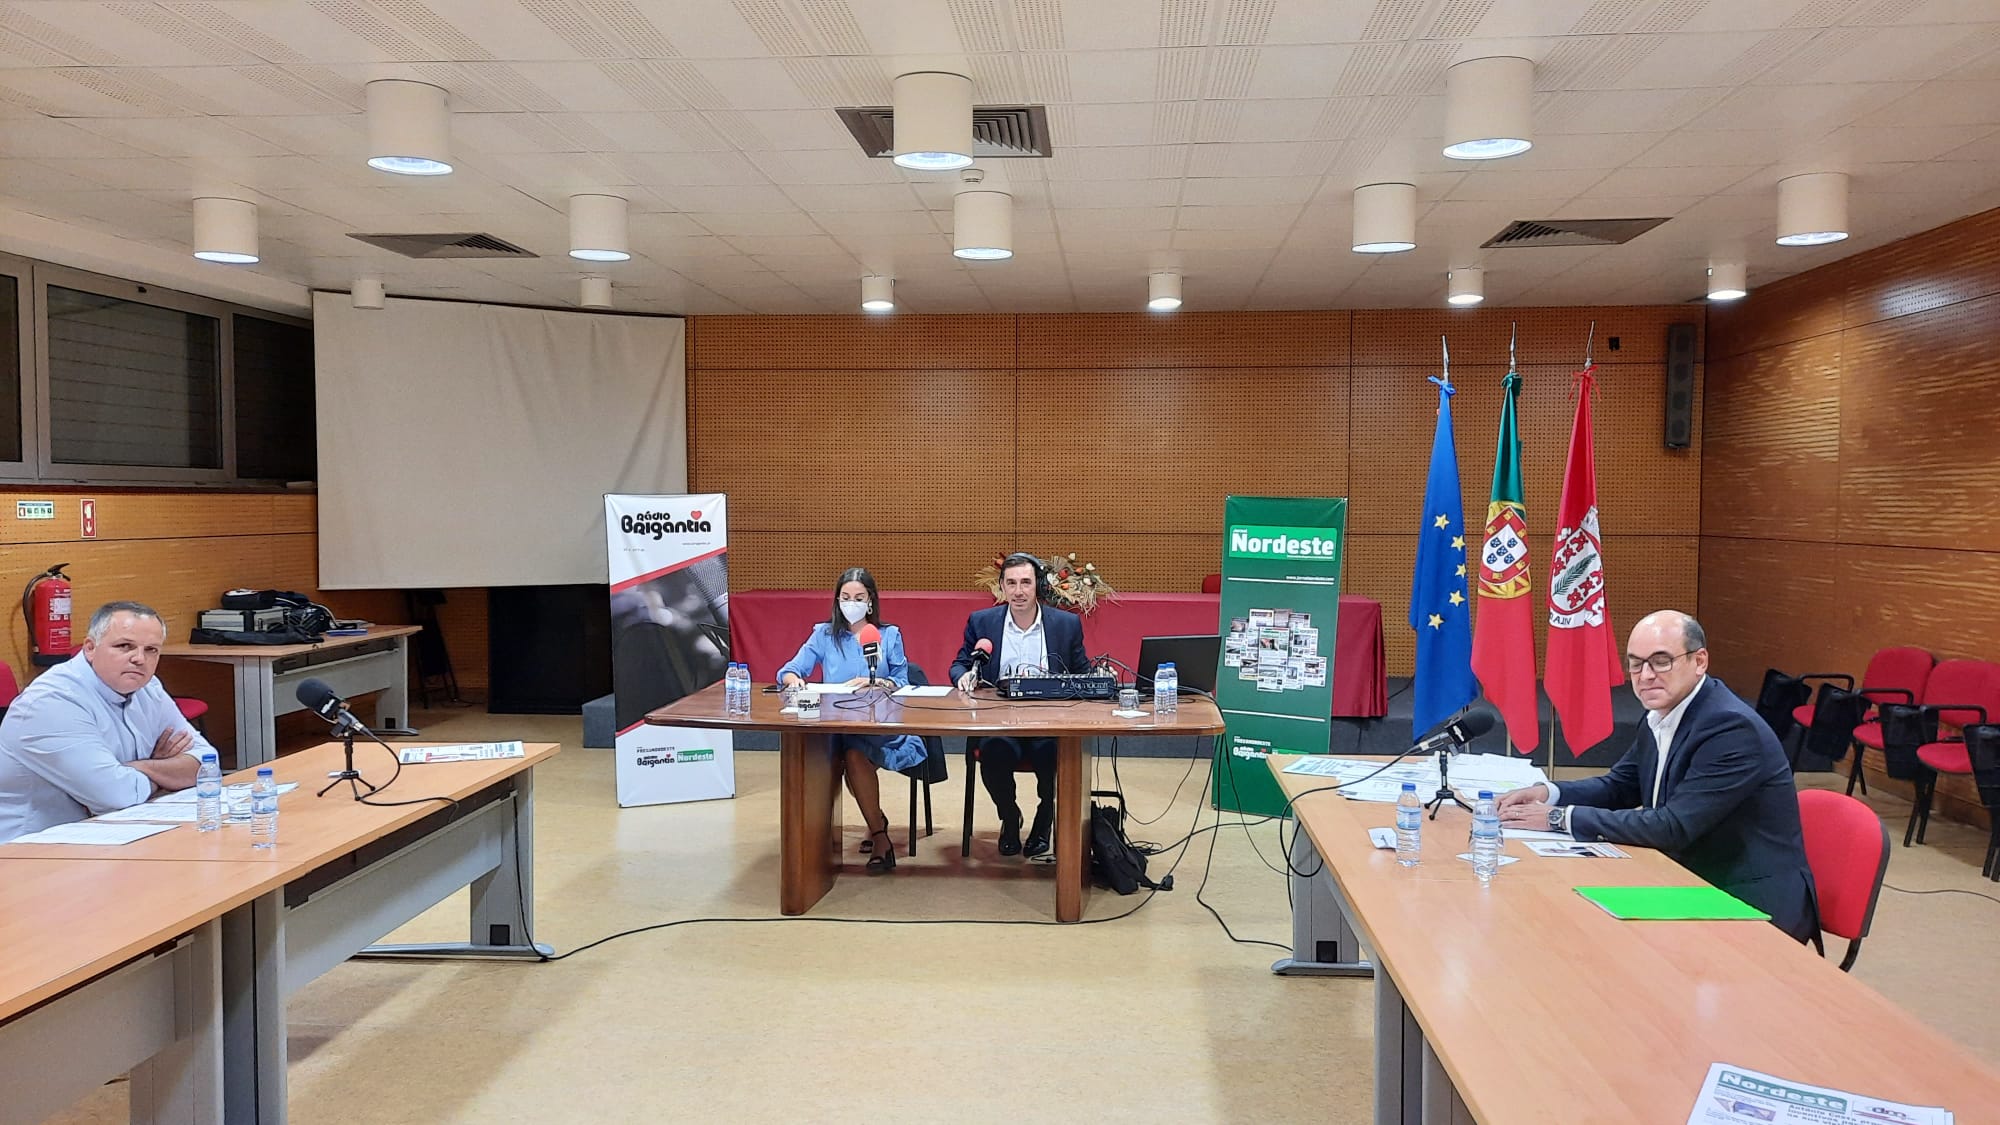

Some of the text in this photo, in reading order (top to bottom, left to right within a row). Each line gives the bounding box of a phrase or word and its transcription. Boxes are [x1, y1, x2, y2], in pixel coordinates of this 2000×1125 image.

[621, 515, 712, 541] Brigantia
[1231, 533, 1335, 556] Nordeste
[1722, 1073, 1844, 1110] Nordeste
